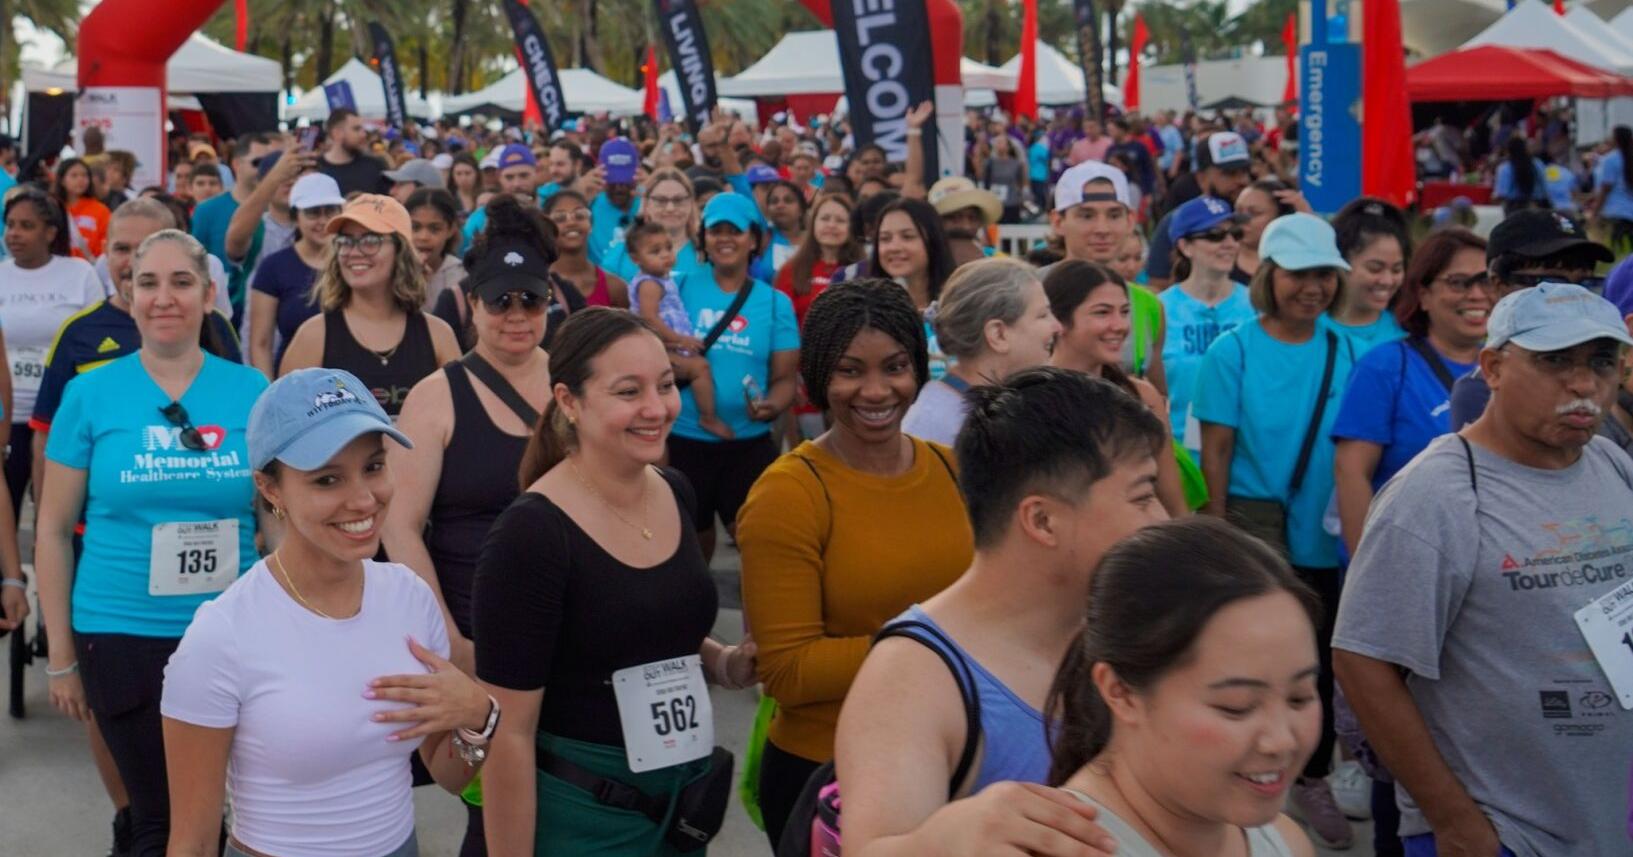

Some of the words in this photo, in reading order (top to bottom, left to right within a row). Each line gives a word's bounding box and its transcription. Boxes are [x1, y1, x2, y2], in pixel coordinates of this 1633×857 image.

[670, 13, 707, 105] LIVING
[524, 34, 561, 126] CHECK
[1305, 52, 1327, 187] Emergency
[14, 361, 43, 378] 593
[134, 451, 240, 469] Memorial
[120, 467, 201, 483] Healthcare
[177, 549, 217, 574] 135
[1524, 553, 1574, 567] American
[662, 660, 687, 672] WALK
[651, 695, 699, 736] 562
